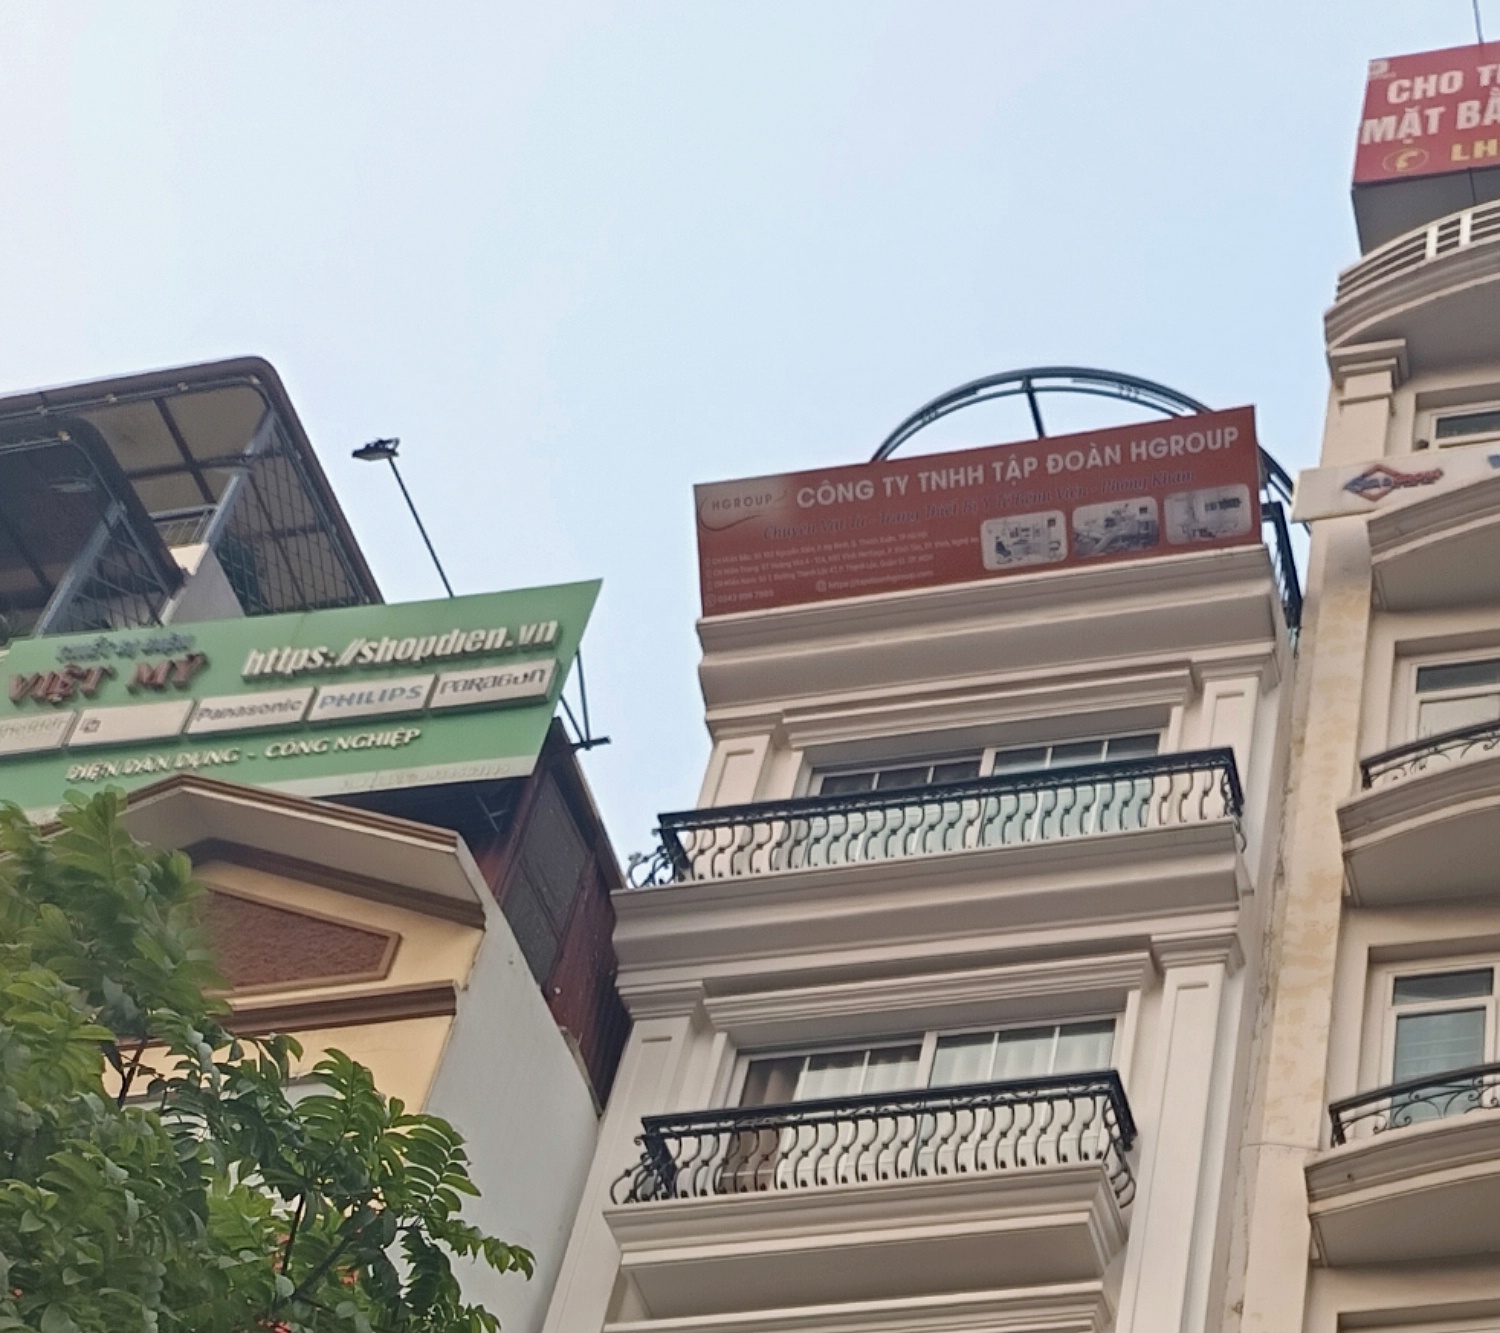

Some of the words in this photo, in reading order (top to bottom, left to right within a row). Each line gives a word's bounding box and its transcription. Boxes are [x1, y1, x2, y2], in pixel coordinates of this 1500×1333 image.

[1386, 69, 1464, 104] CHO
[1360, 105, 1447, 145] MẶT
[796, 479, 875, 508] CÔNG
[882, 475, 909, 497] TY
[918, 464, 984, 493] TNHH
[992, 453, 1038, 486] TẬP
[1045, 441, 1122, 475] ĐOÀN
[1130, 426, 1240, 463] HGROUP
[711, 493, 774, 511] HGROUP
[196, 698, 305, 723] Panasonic
[319, 684, 424, 710] PHILIPS
[333, 726, 422, 753] NGHIỆP
